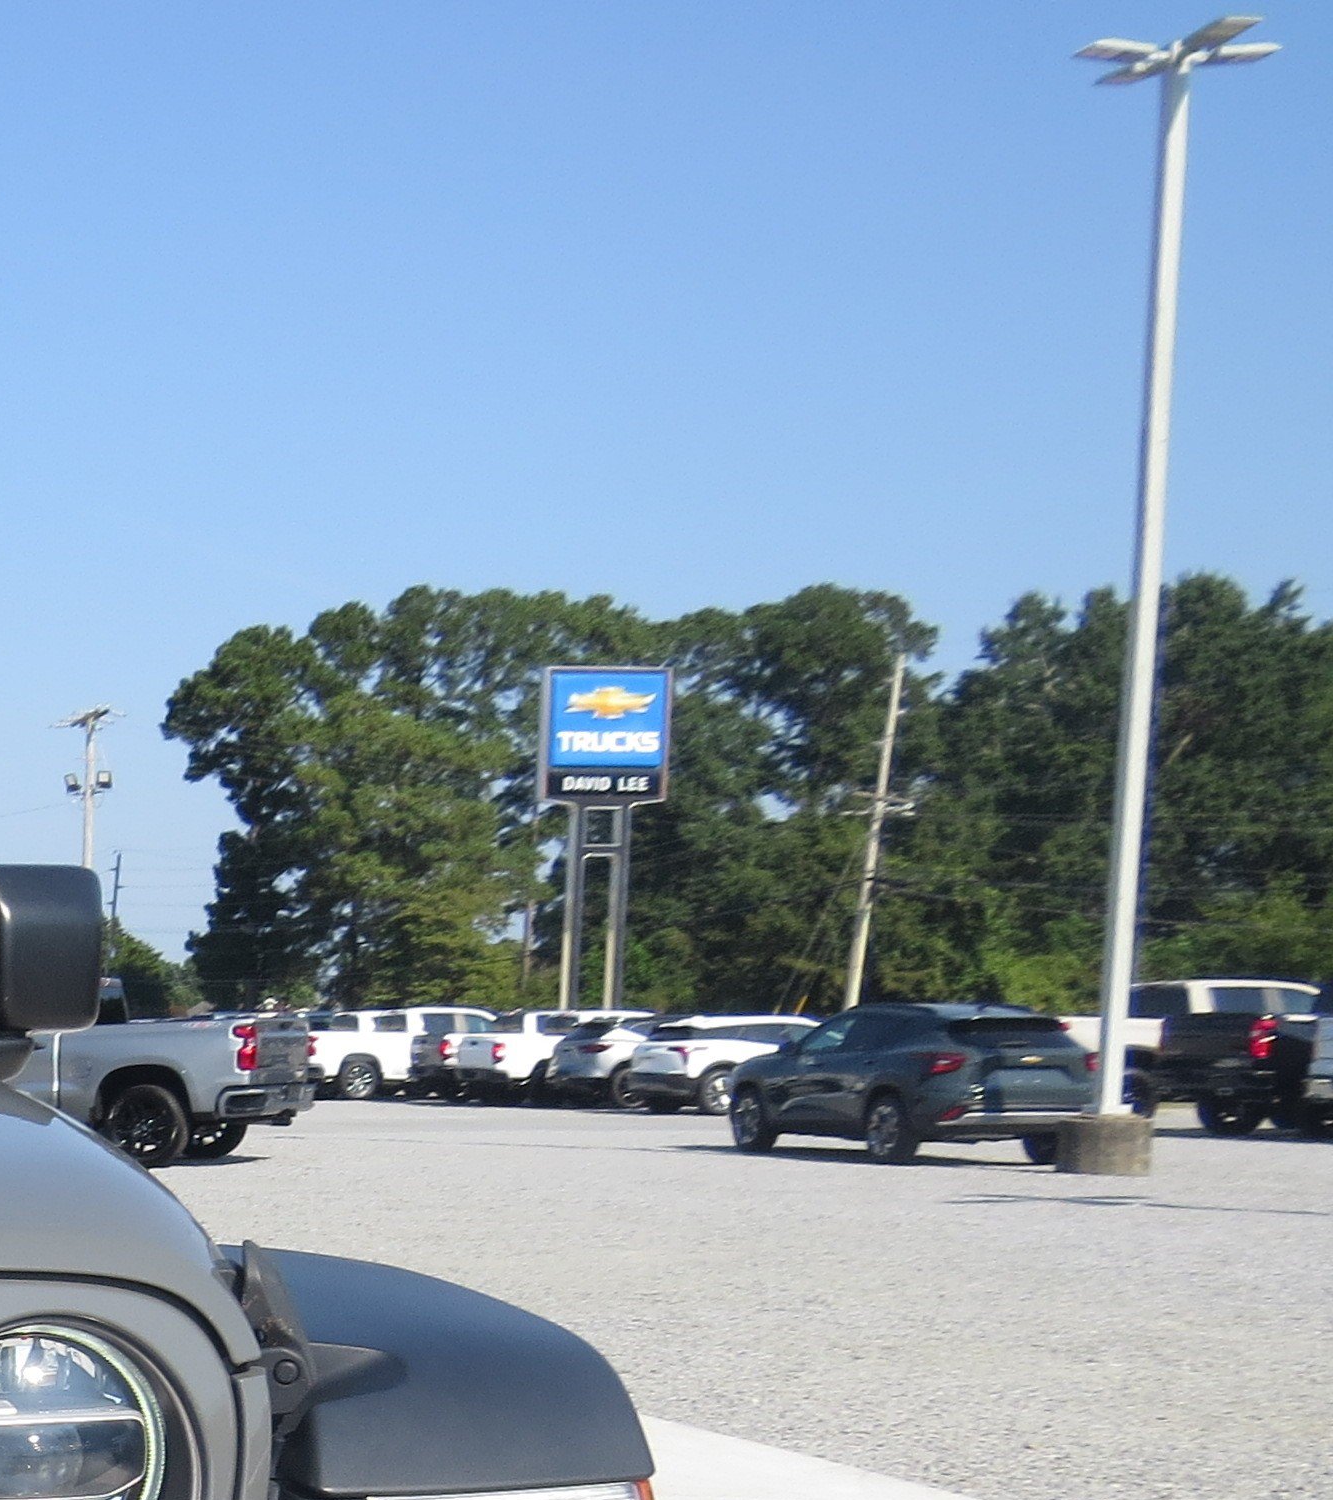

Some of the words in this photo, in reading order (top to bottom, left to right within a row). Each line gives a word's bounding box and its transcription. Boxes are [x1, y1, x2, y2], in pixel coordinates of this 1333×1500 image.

[556, 730, 661, 753] TRUCKS
[561, 775, 612, 792] DAVID
[616, 775, 650, 792] LEE
